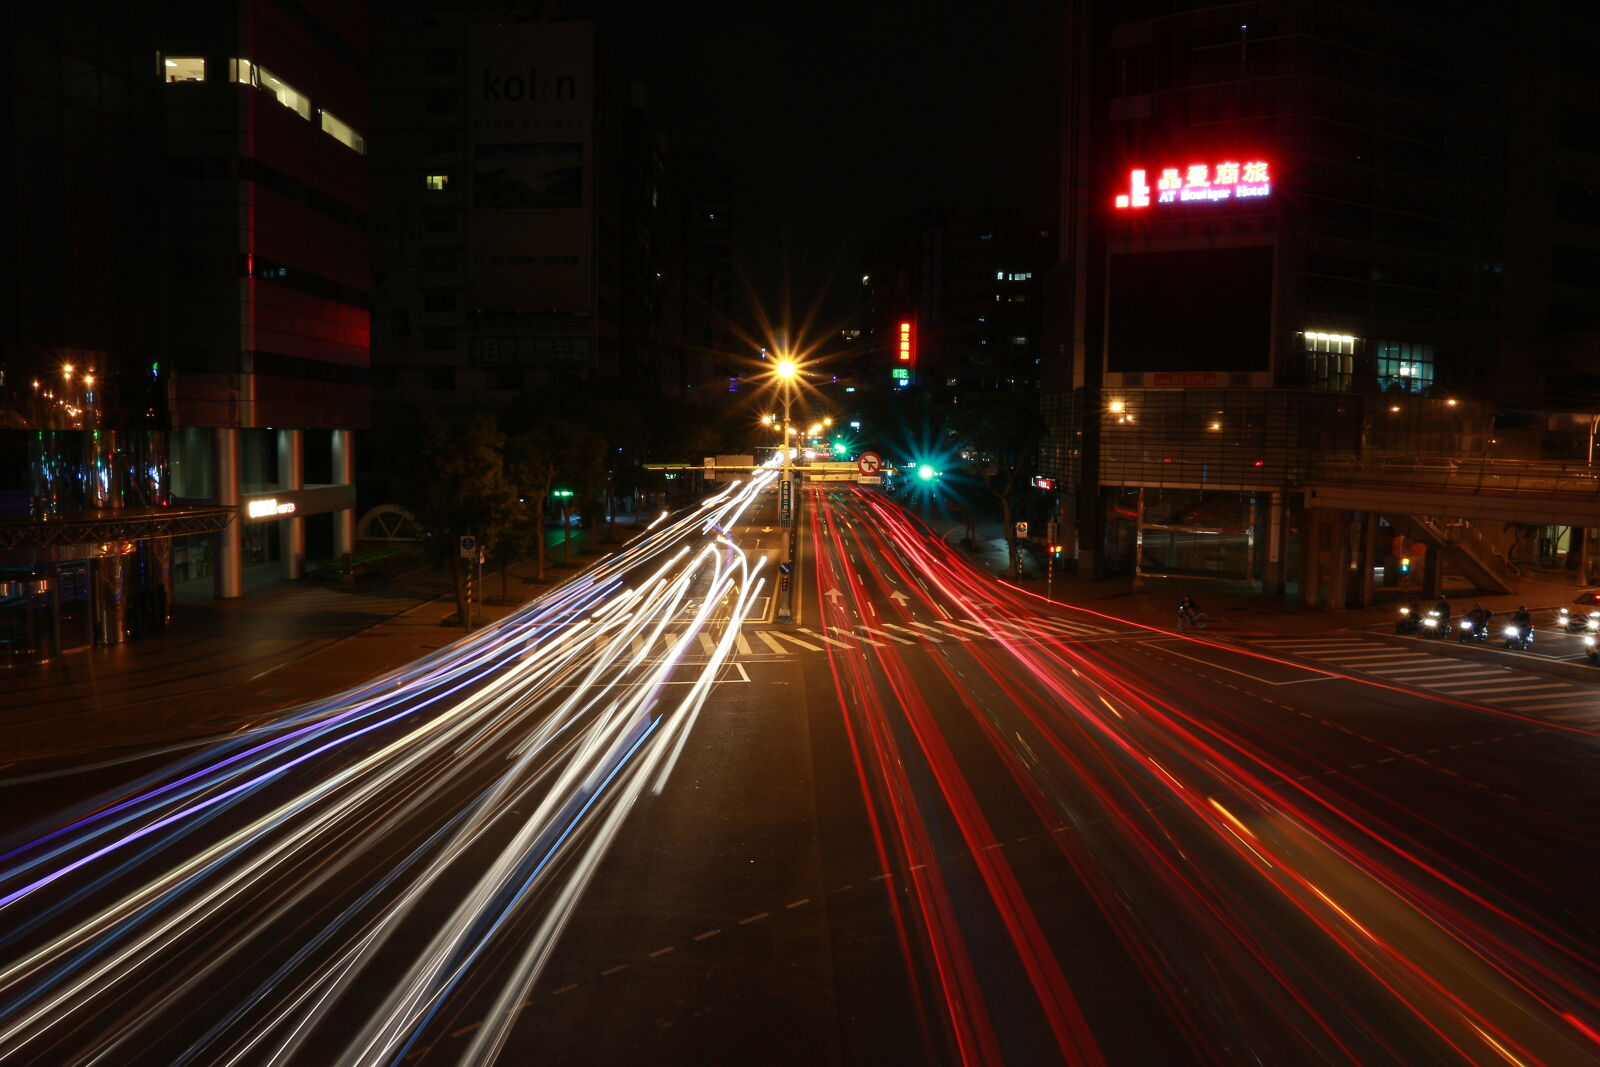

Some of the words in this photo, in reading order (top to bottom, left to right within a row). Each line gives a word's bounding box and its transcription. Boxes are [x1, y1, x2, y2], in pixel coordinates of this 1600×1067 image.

[483, 66, 576, 102] kolin
[1158, 190, 1176, 203] AT
[1180, 188, 1231, 202] Boutique
[1235, 184, 1270, 198] Hotel
